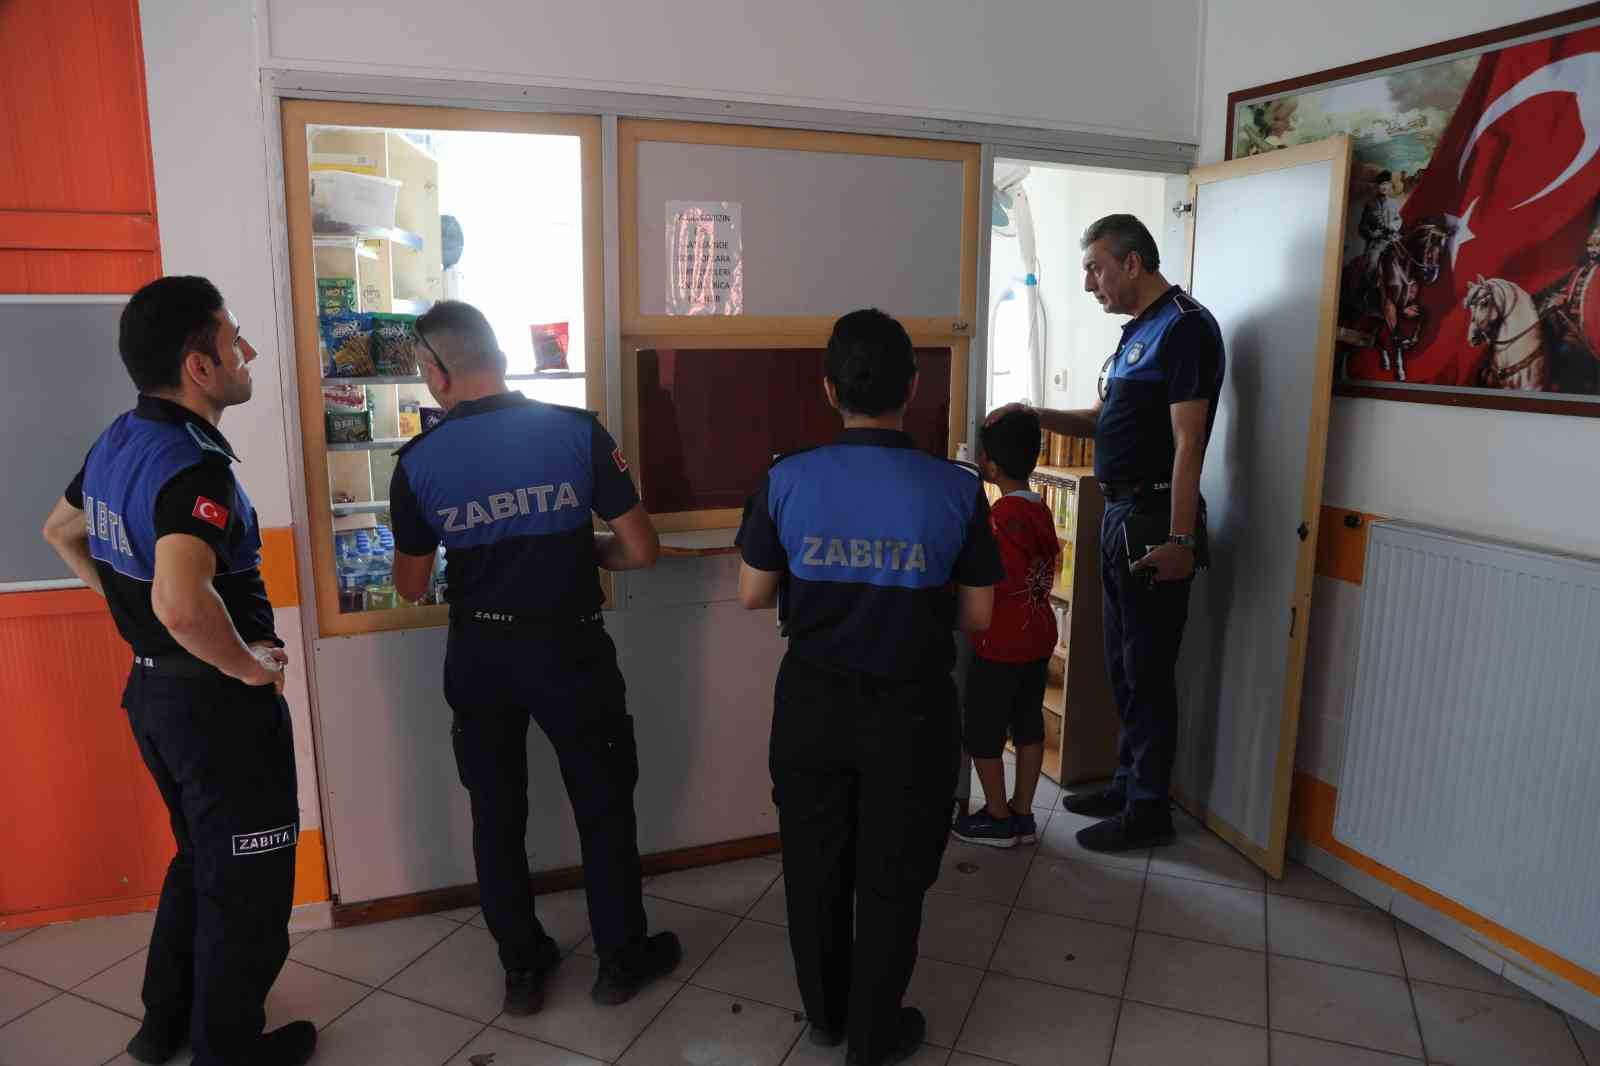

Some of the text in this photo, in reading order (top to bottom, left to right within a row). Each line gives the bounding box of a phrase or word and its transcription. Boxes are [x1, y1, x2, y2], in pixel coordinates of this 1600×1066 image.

[436, 482, 580, 532] ZABITA
[801, 536, 928, 573] ZABITA
[239, 831, 290, 850] ZABITA
